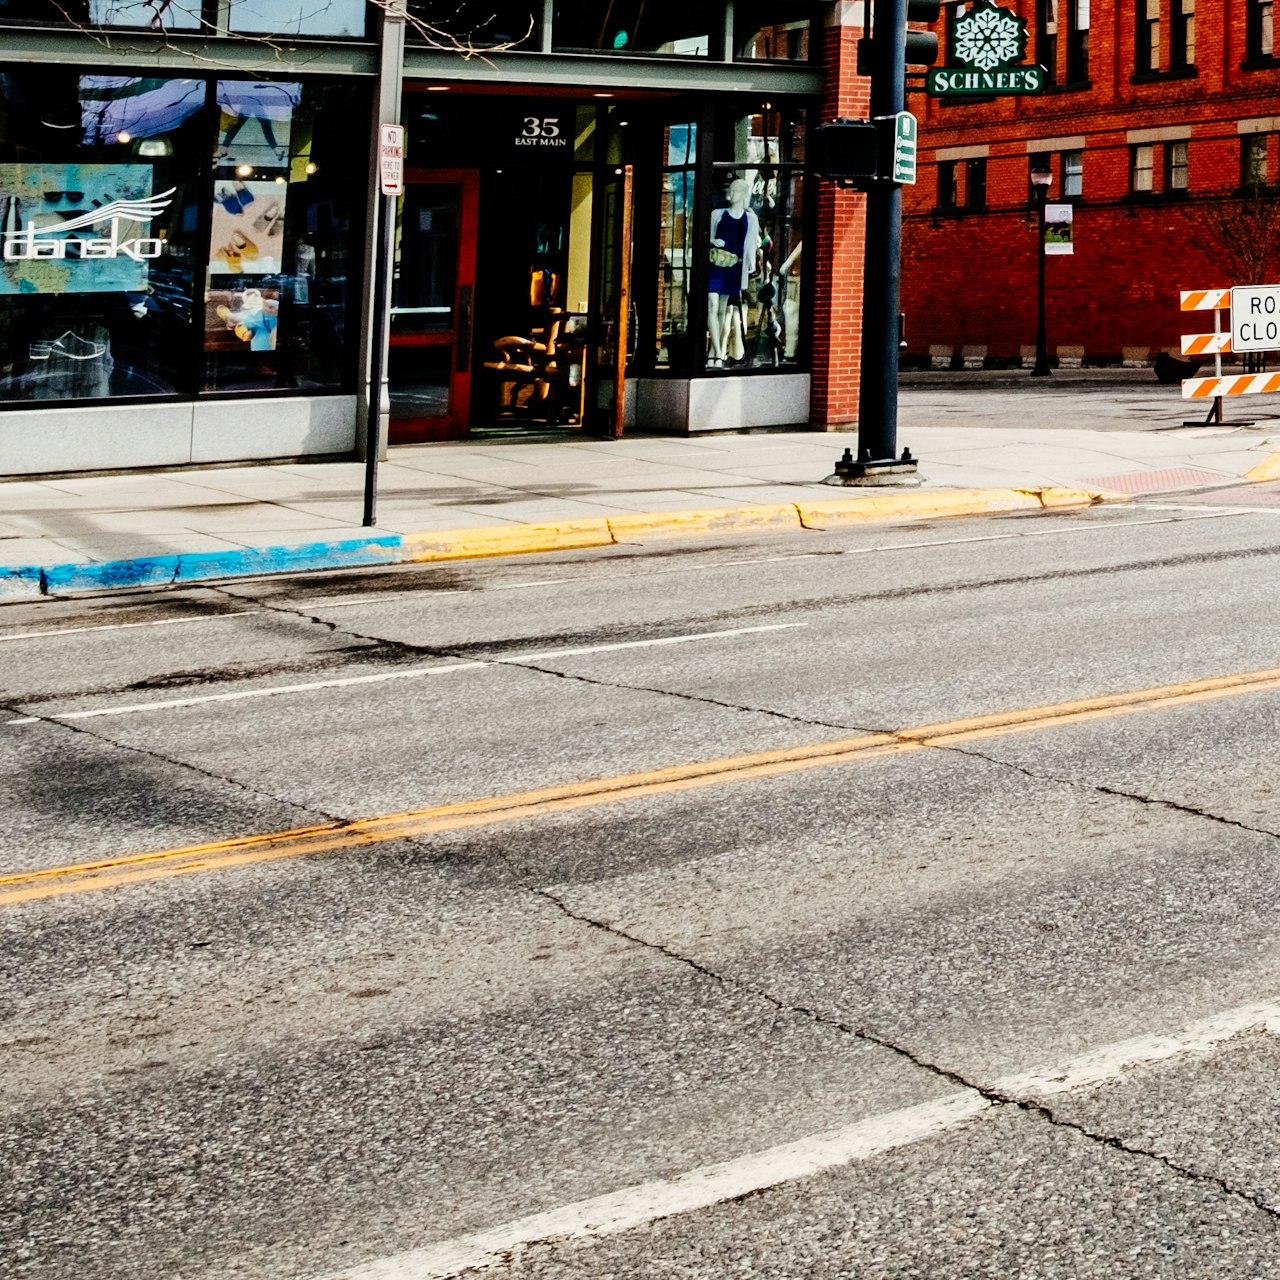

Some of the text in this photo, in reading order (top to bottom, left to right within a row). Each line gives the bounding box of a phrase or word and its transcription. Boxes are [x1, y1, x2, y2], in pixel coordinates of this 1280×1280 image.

[934, 70, 1039, 92] SCHNEE'S
[522, 117, 560, 137] 35
[515, 138, 567, 147] EAST MAIN
[4, 218, 162, 262] dansko
